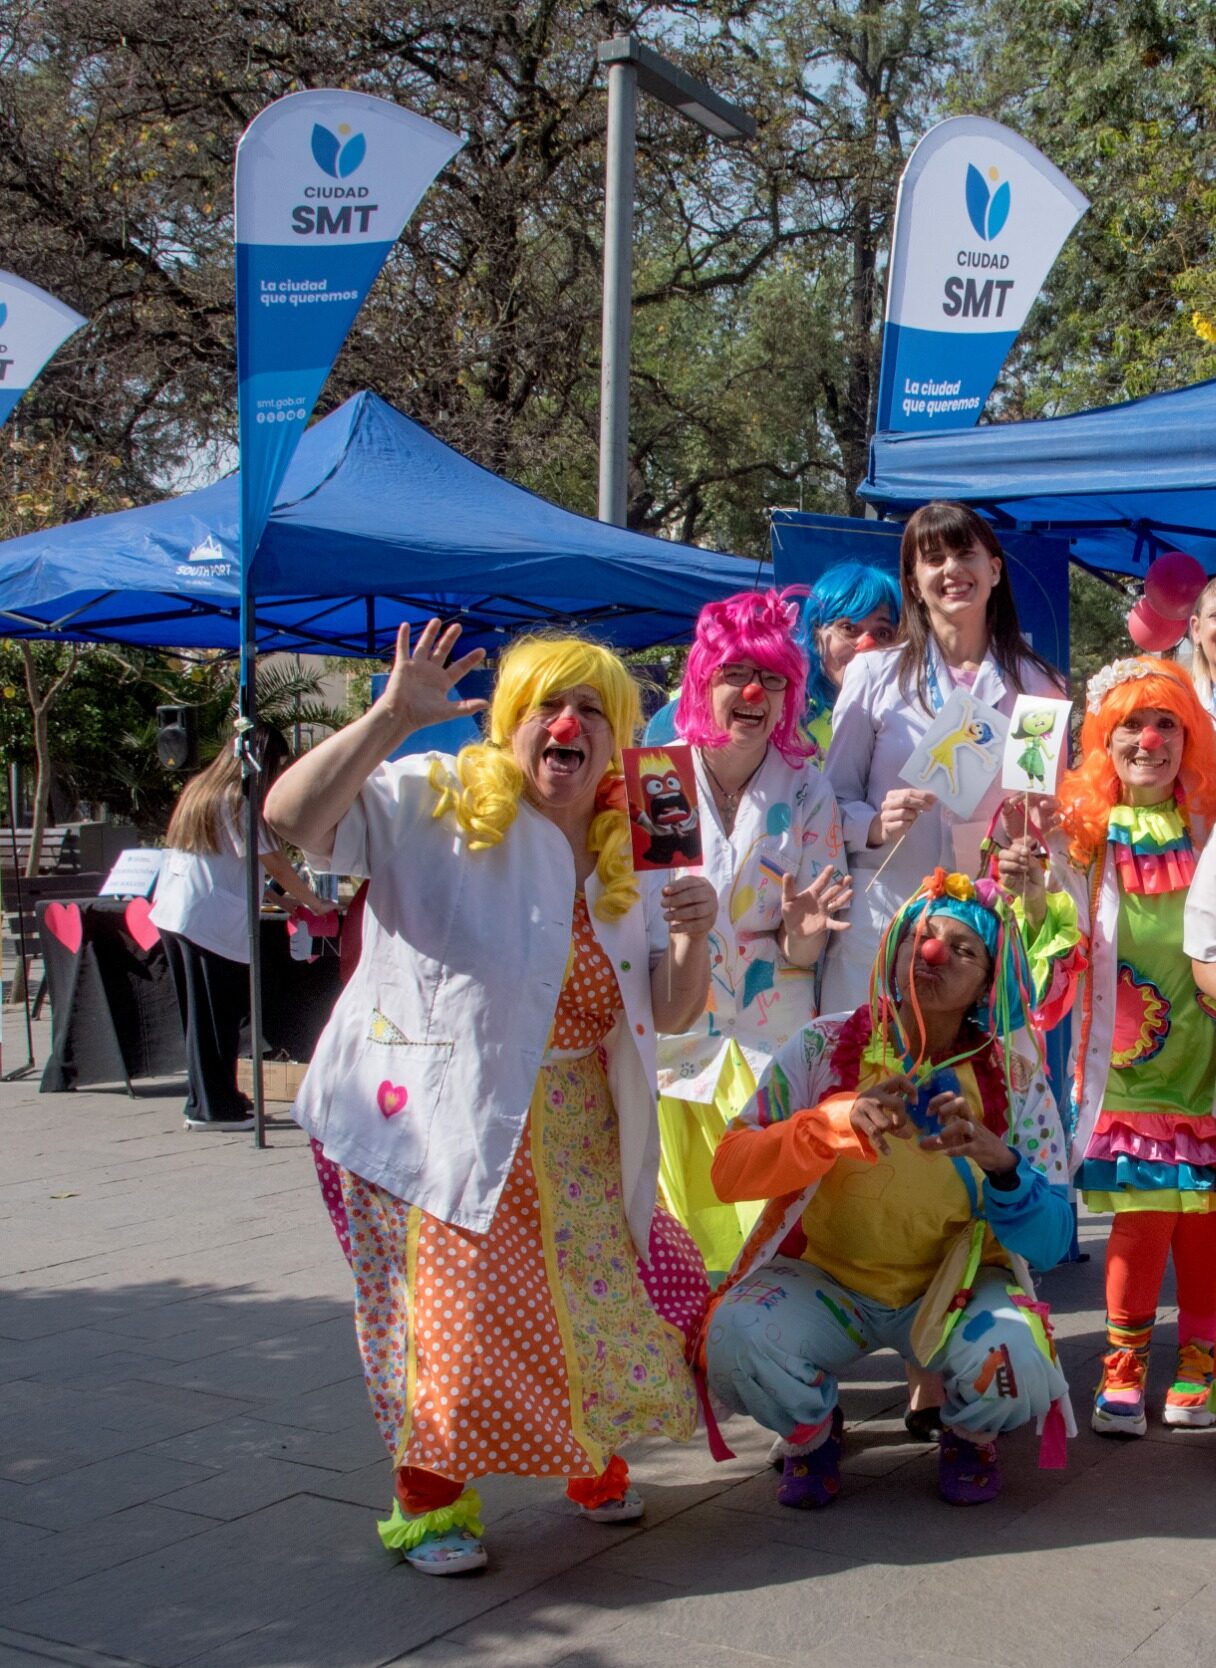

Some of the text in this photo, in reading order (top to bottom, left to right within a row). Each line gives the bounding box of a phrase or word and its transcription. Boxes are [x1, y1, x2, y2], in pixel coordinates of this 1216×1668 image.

[304, 186, 369, 199] CIUDAD
[291, 204, 378, 235] SMT
[957, 250, 1010, 269] CIUDAD
[261, 279, 327, 291] La ciudad
[260, 289, 358, 307] que queremos
[942, 276, 1015, 318] SMT
[905, 379, 961, 395] La ciudad
[257, 397, 305, 410] smt.gob.ar
[903, 397, 980, 417] que queremos
